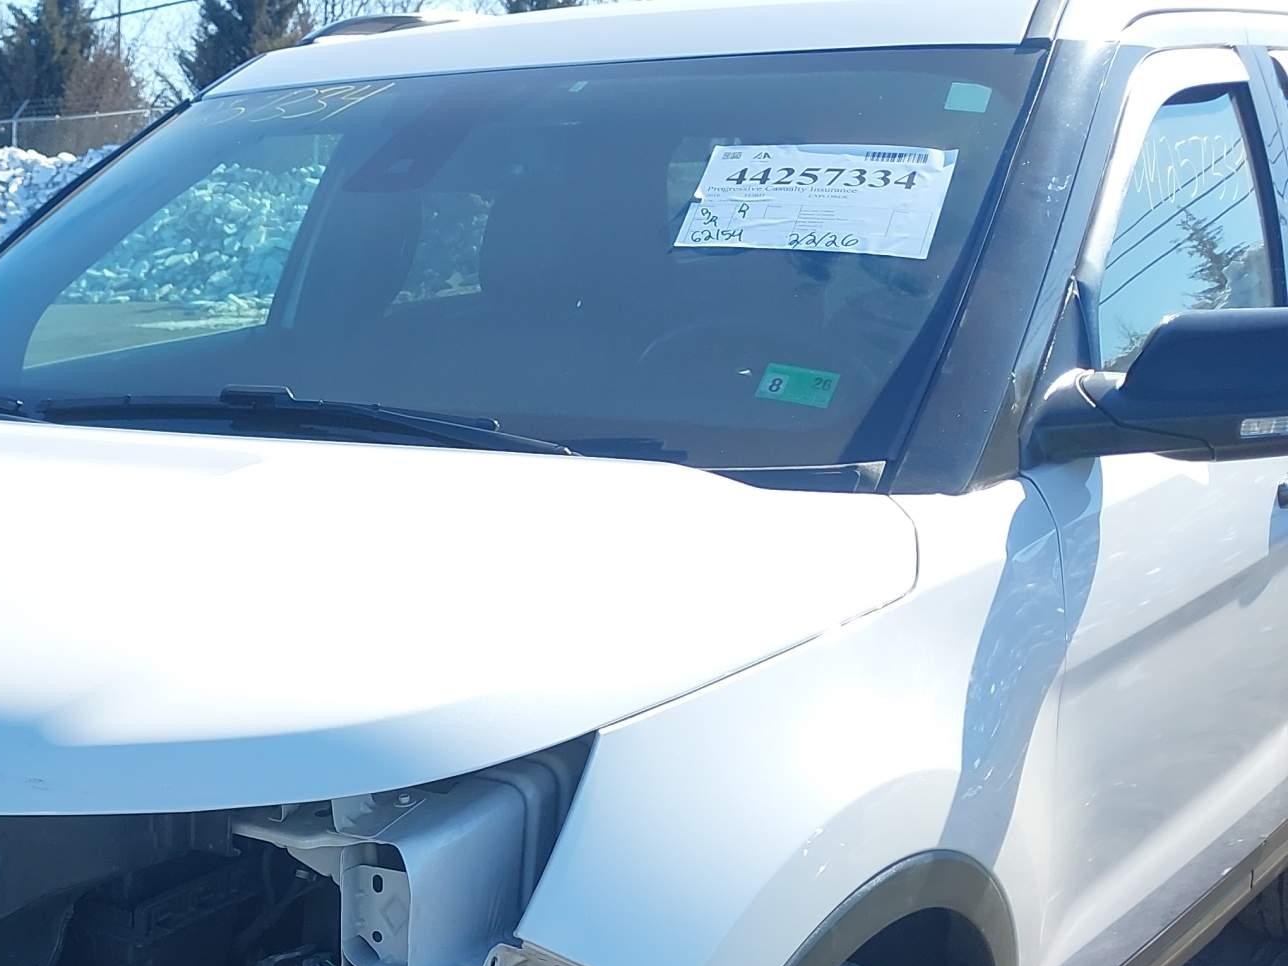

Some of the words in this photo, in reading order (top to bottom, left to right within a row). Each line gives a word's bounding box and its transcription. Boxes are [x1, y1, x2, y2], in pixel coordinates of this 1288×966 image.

[726, 167, 917, 190] 44257334
[707, 185, 762, 194] Progressive
[765, 185, 808, 194] Casualty
[811, 186, 858, 194] Insurance
[691, 228, 744, 243] 62154
[787, 231, 859, 249] 2/2/26
[768, 377, 783, 393] 8
